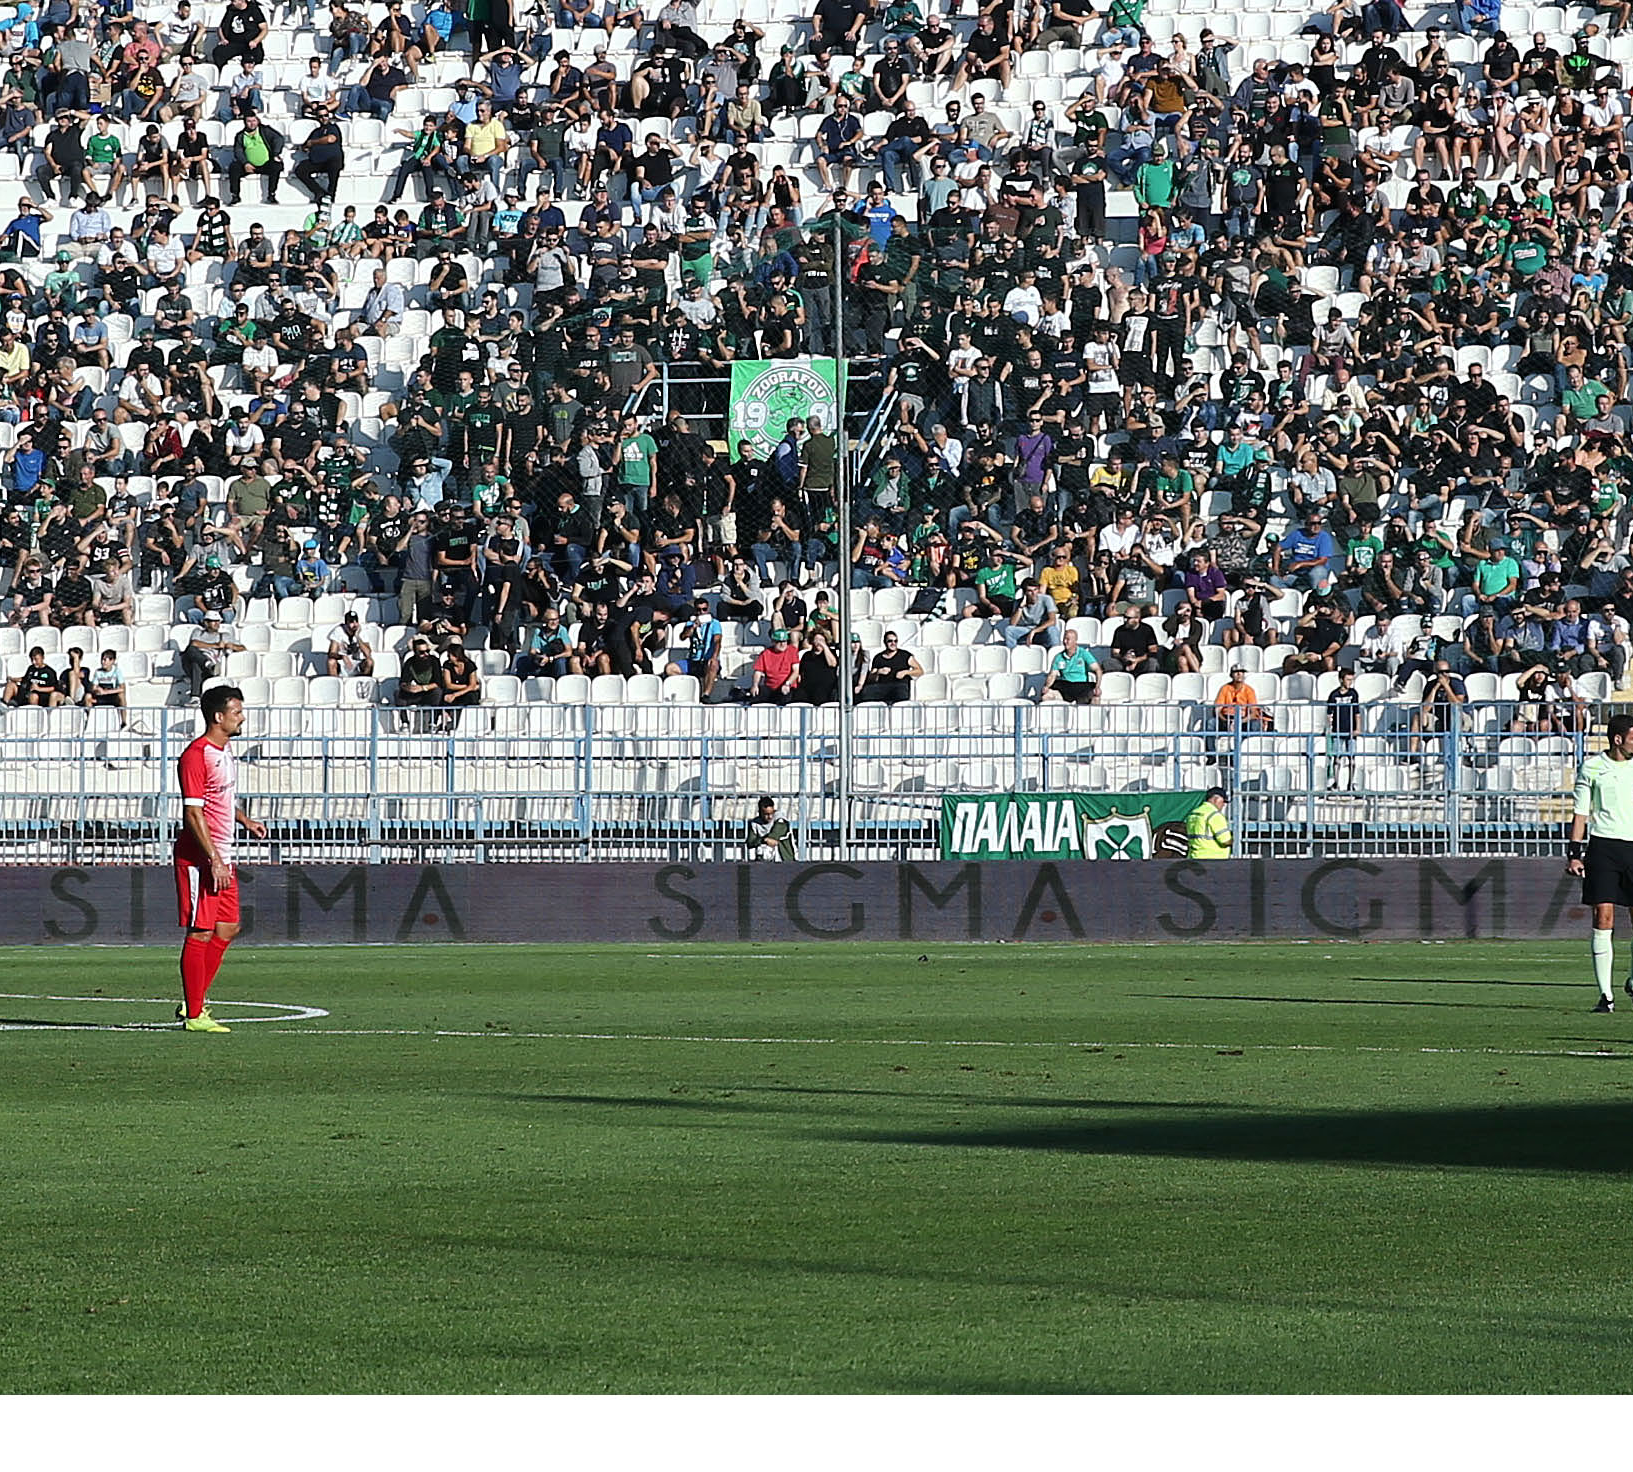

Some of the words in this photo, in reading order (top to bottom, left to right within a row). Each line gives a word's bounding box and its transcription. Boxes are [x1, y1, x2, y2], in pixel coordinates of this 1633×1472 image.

[752, 371, 827, 399] ZOGRAFOU
[732, 400, 768, 429] 19
[93, 546, 110, 562] 93
[950, 799, 1081, 853] ΠΑΛΑΙΑ
[648, 862, 1087, 940] SIGMA
